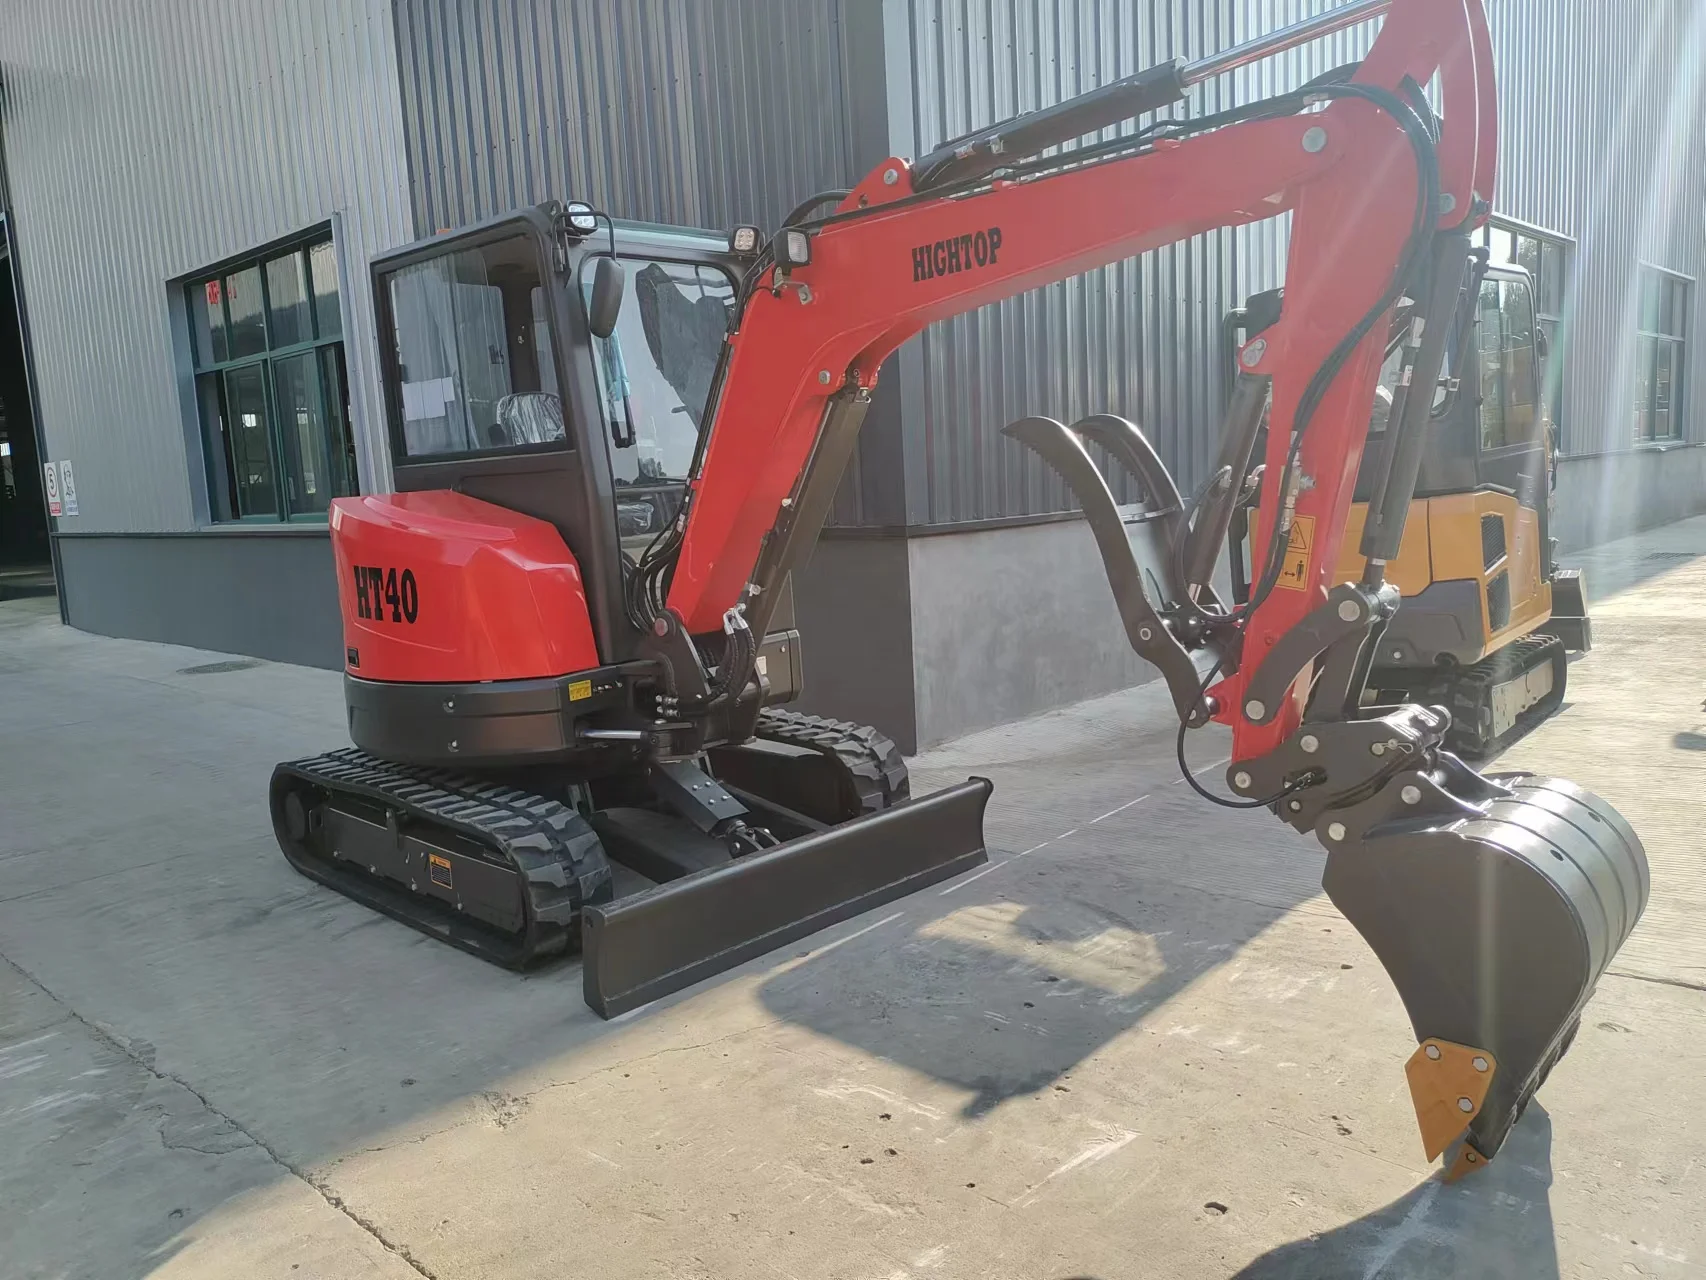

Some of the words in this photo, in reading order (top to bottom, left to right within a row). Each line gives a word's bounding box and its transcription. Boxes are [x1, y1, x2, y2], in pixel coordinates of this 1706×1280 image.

[912, 227, 1002, 282] HIGHTOP
[49, 473, 54, 490] 5
[354, 565, 418, 624] HT40
